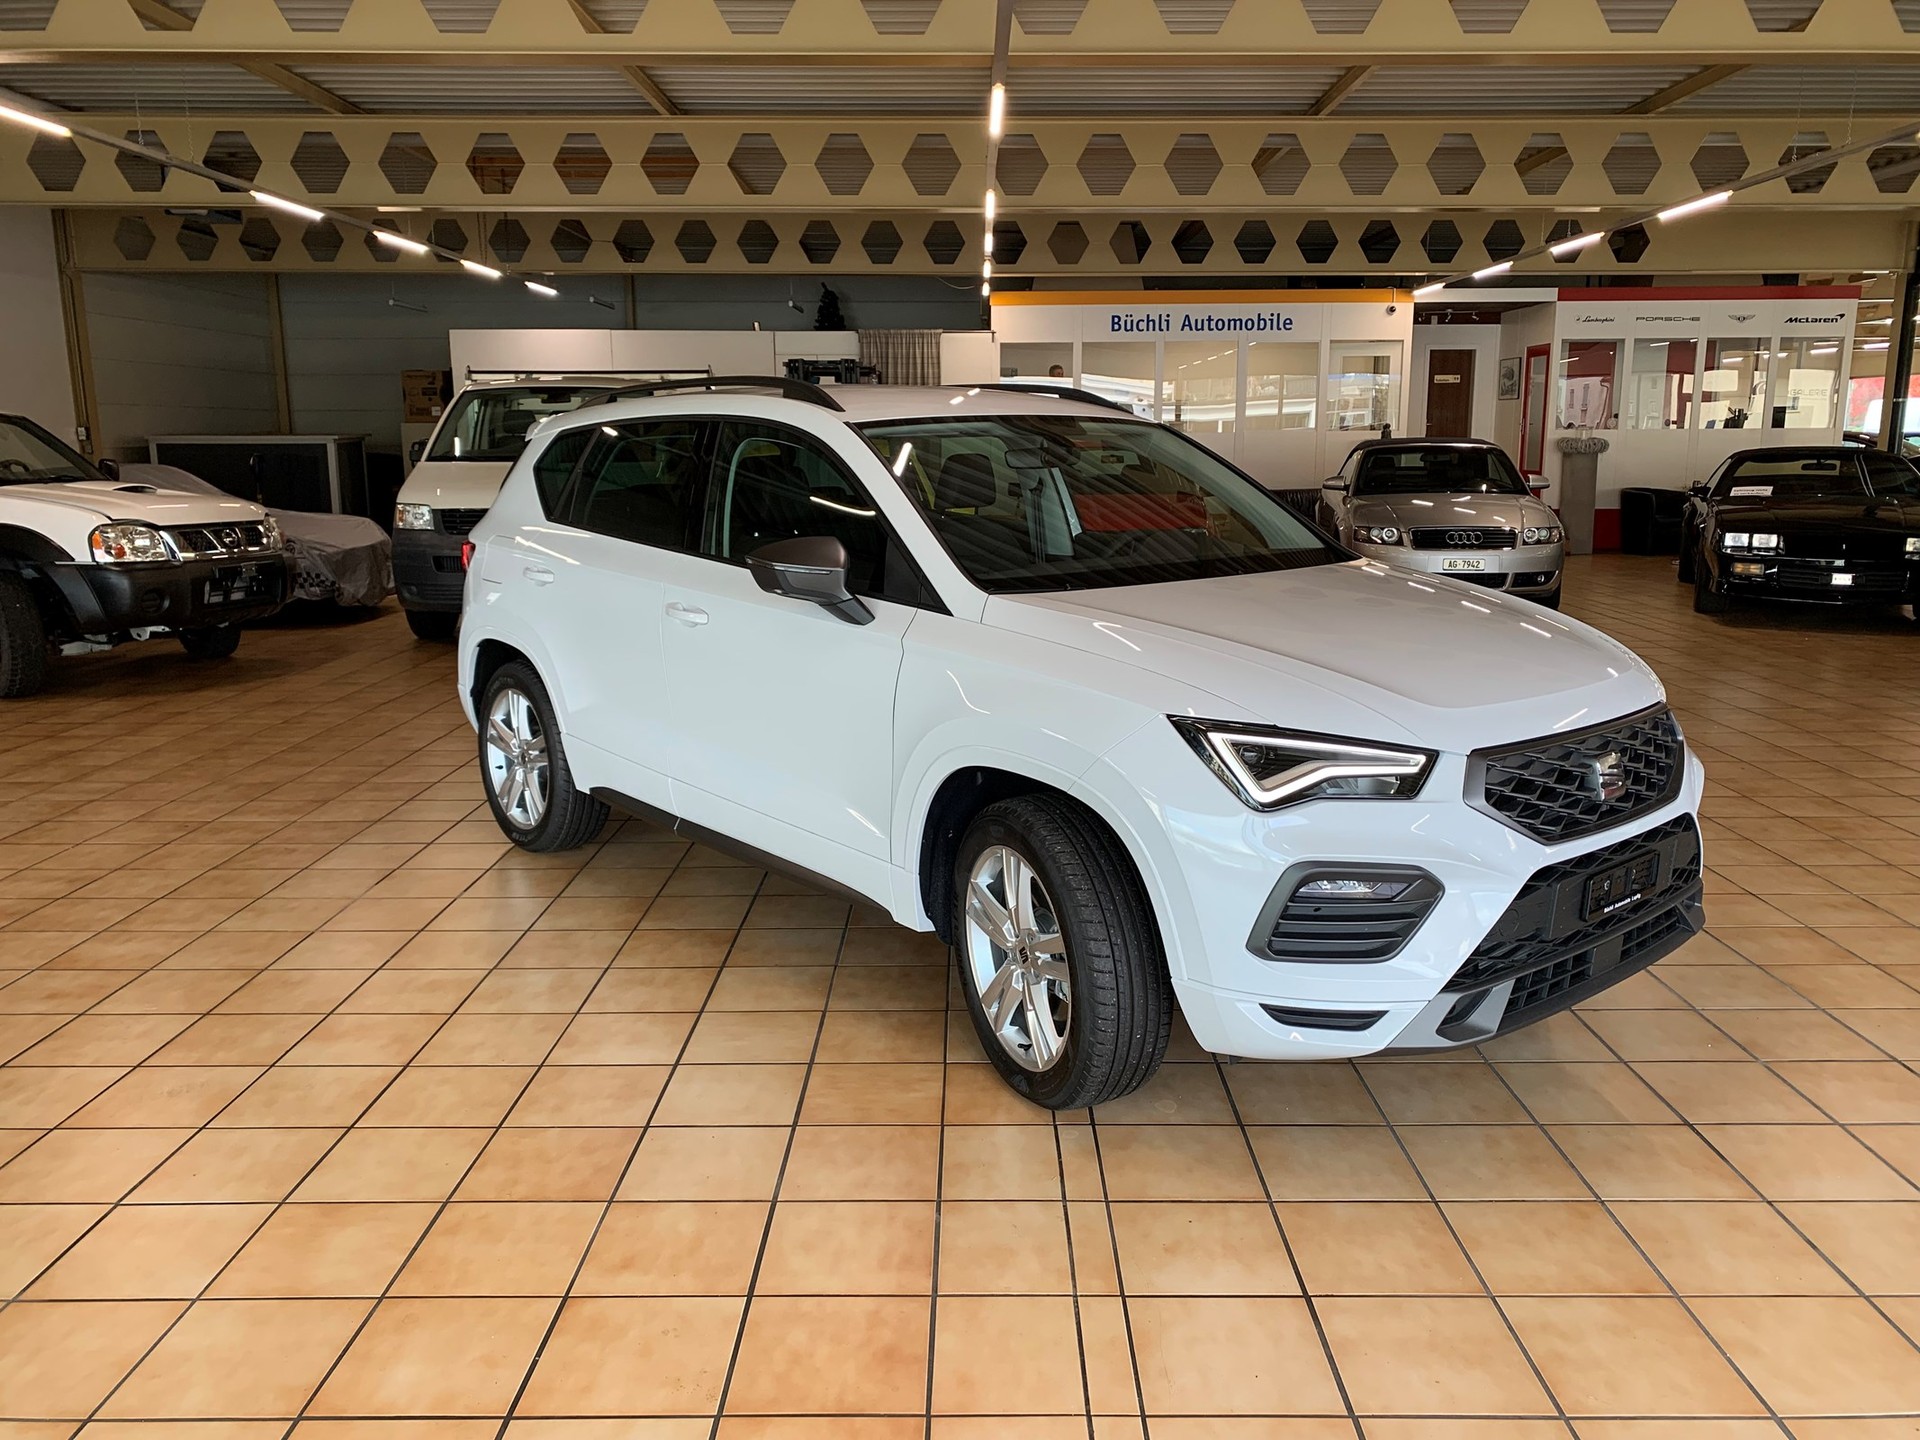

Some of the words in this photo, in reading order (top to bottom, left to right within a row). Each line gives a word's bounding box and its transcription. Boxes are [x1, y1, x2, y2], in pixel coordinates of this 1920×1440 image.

[1110, 313, 1171, 332] Büchli
[1180, 312, 1293, 332] Automobile
[1783, 316, 1839, 324] McLaren
